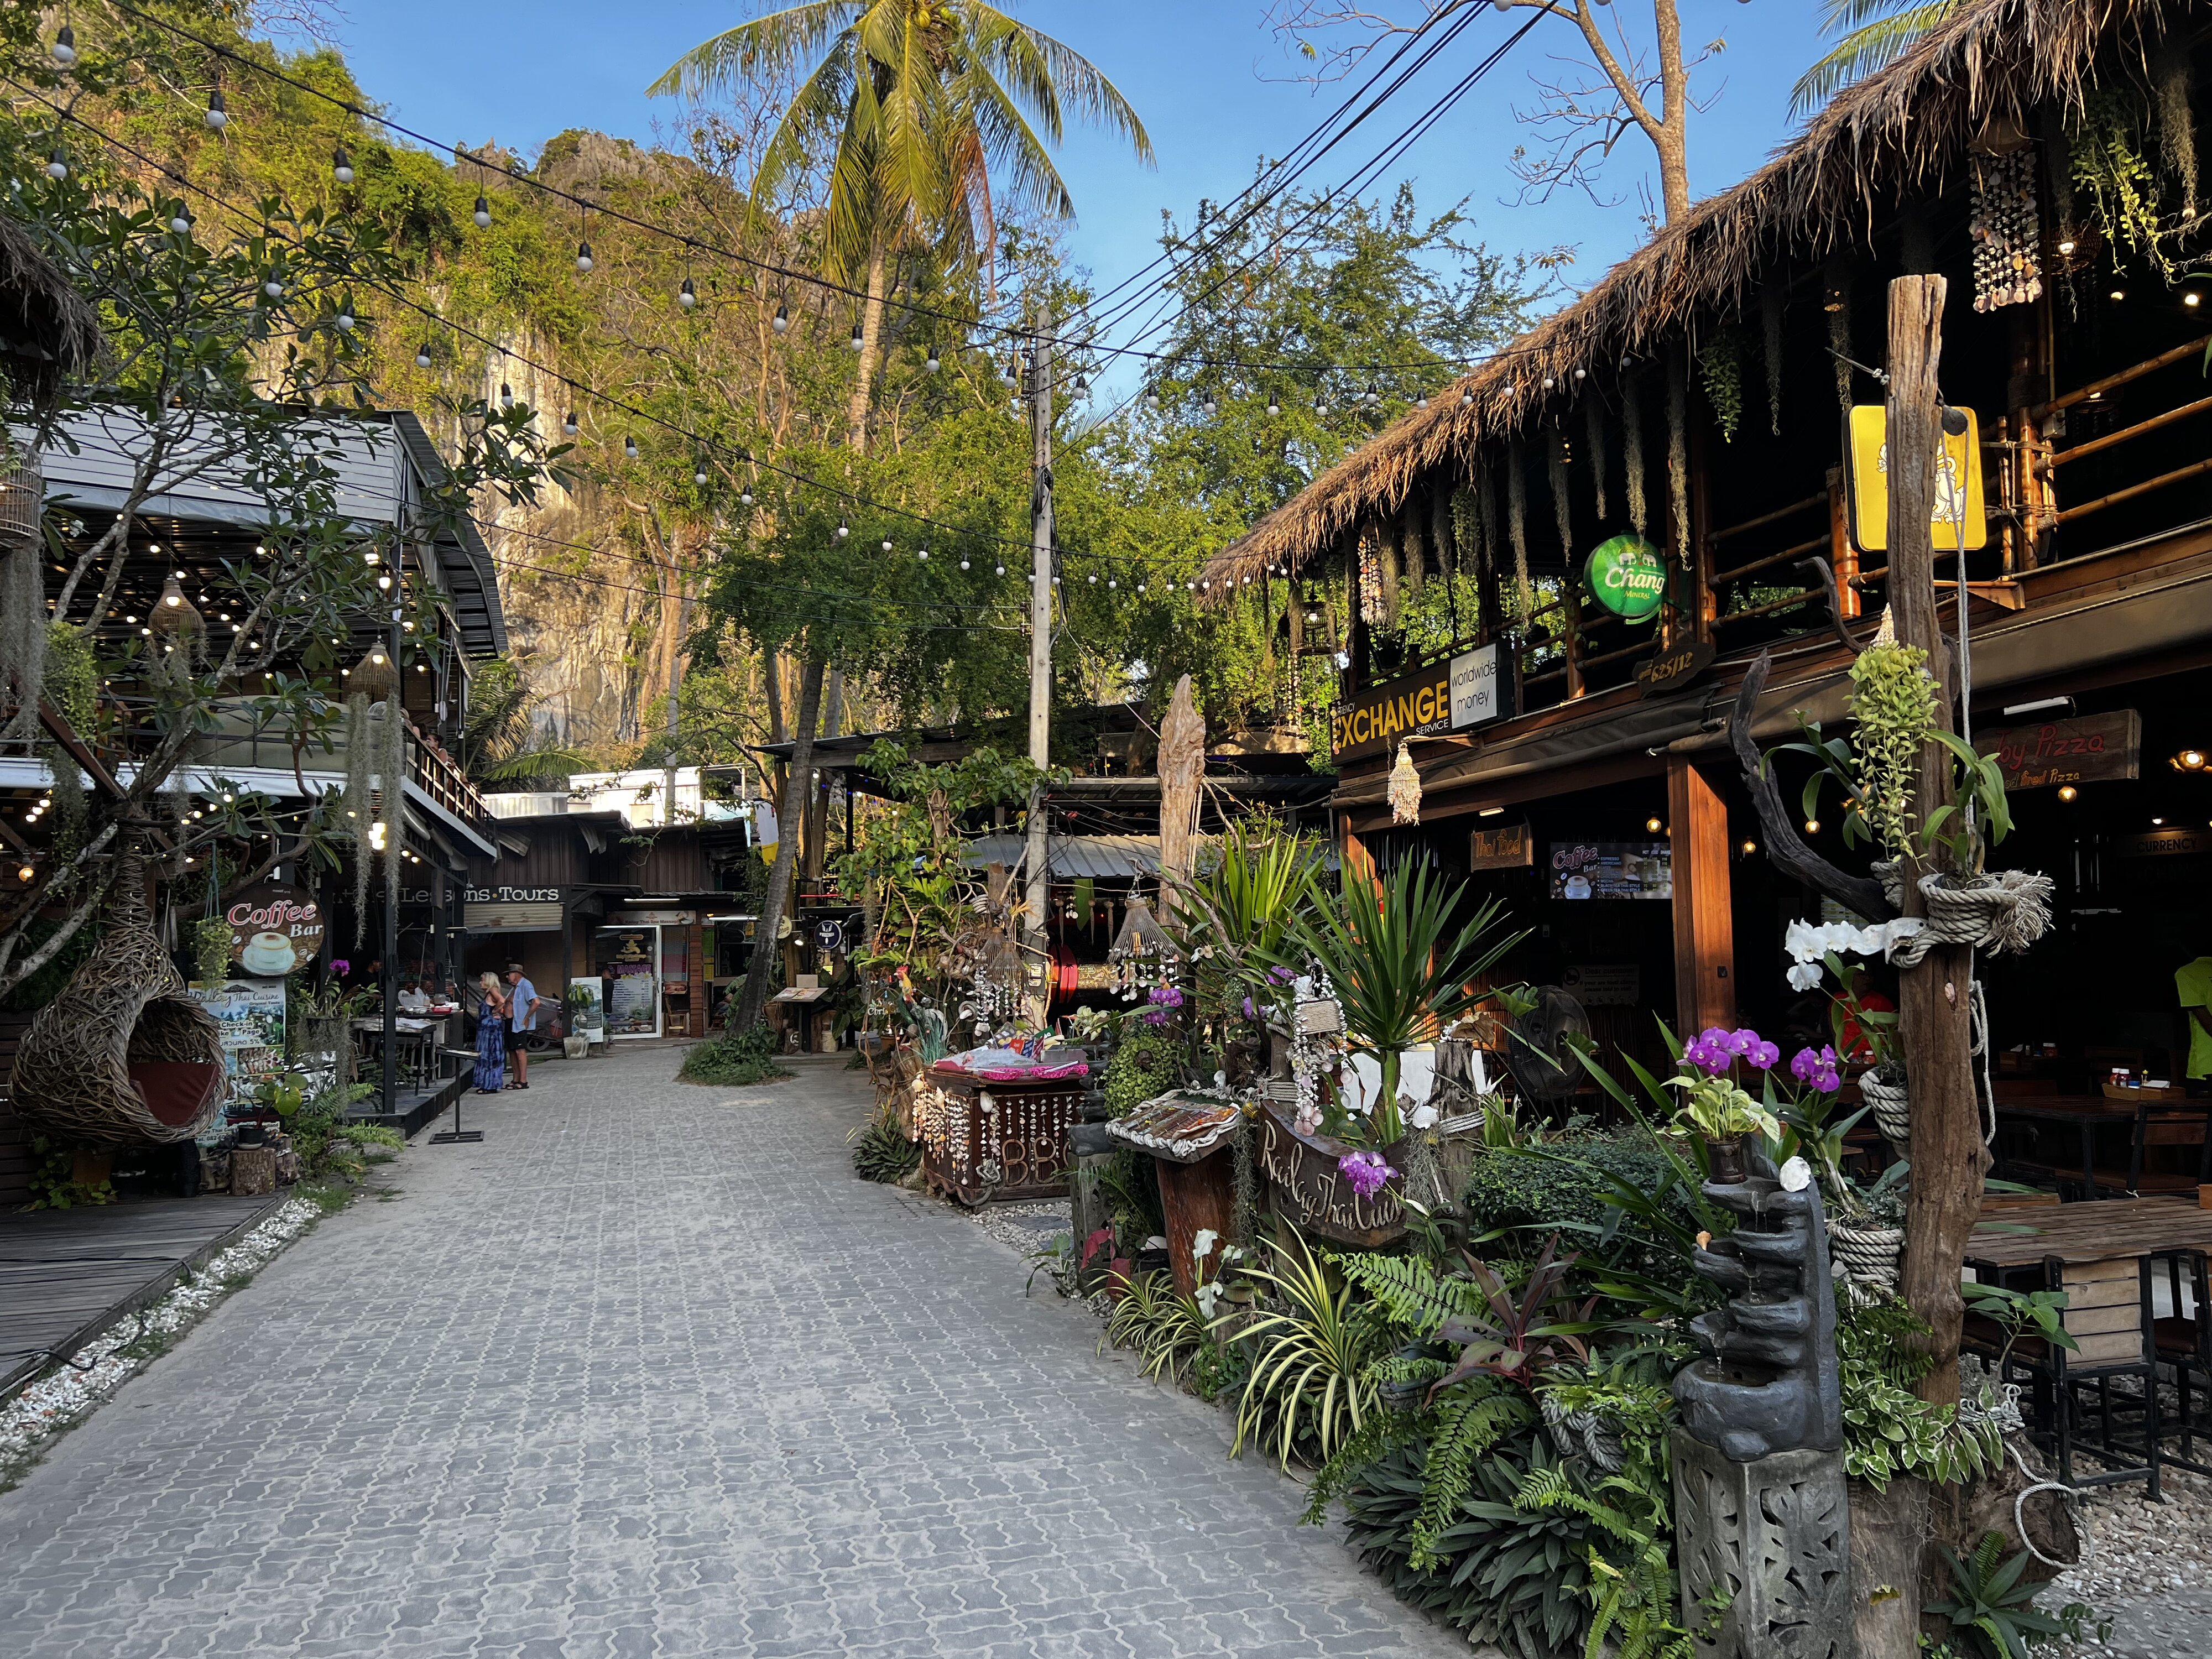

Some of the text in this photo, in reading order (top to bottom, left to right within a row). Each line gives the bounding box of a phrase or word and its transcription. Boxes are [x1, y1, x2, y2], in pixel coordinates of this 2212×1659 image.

[1605, 567, 1665, 595] Chang
[1451, 660, 1496, 688] worldwide
[1651, 651, 1693, 682] 625/12
[1457, 690, 1490, 712] money
[1416, 719, 1449, 735] SERVICE
[2034, 724, 2105, 759] Pizza
[2049, 768, 2080, 784] Pizza
[1474, 832, 1496, 858] Thai
[1552, 845, 1598, 870] Coffee
[2137, 837, 2197, 853] CURRENCY
[1583, 864, 1598, 873] Bar
[498, 886, 560, 902] Tours
[227, 900, 317, 930] Coffee
[289, 924, 323, 938] Bar
[233, 992, 252, 1001] Thai
[253, 992, 279, 1000] Cuisine
[1001, 1136, 1070, 1187] BB
[1261, 1119, 1317, 1225] Railay
[1314, 1172, 1356, 1231] Thai
